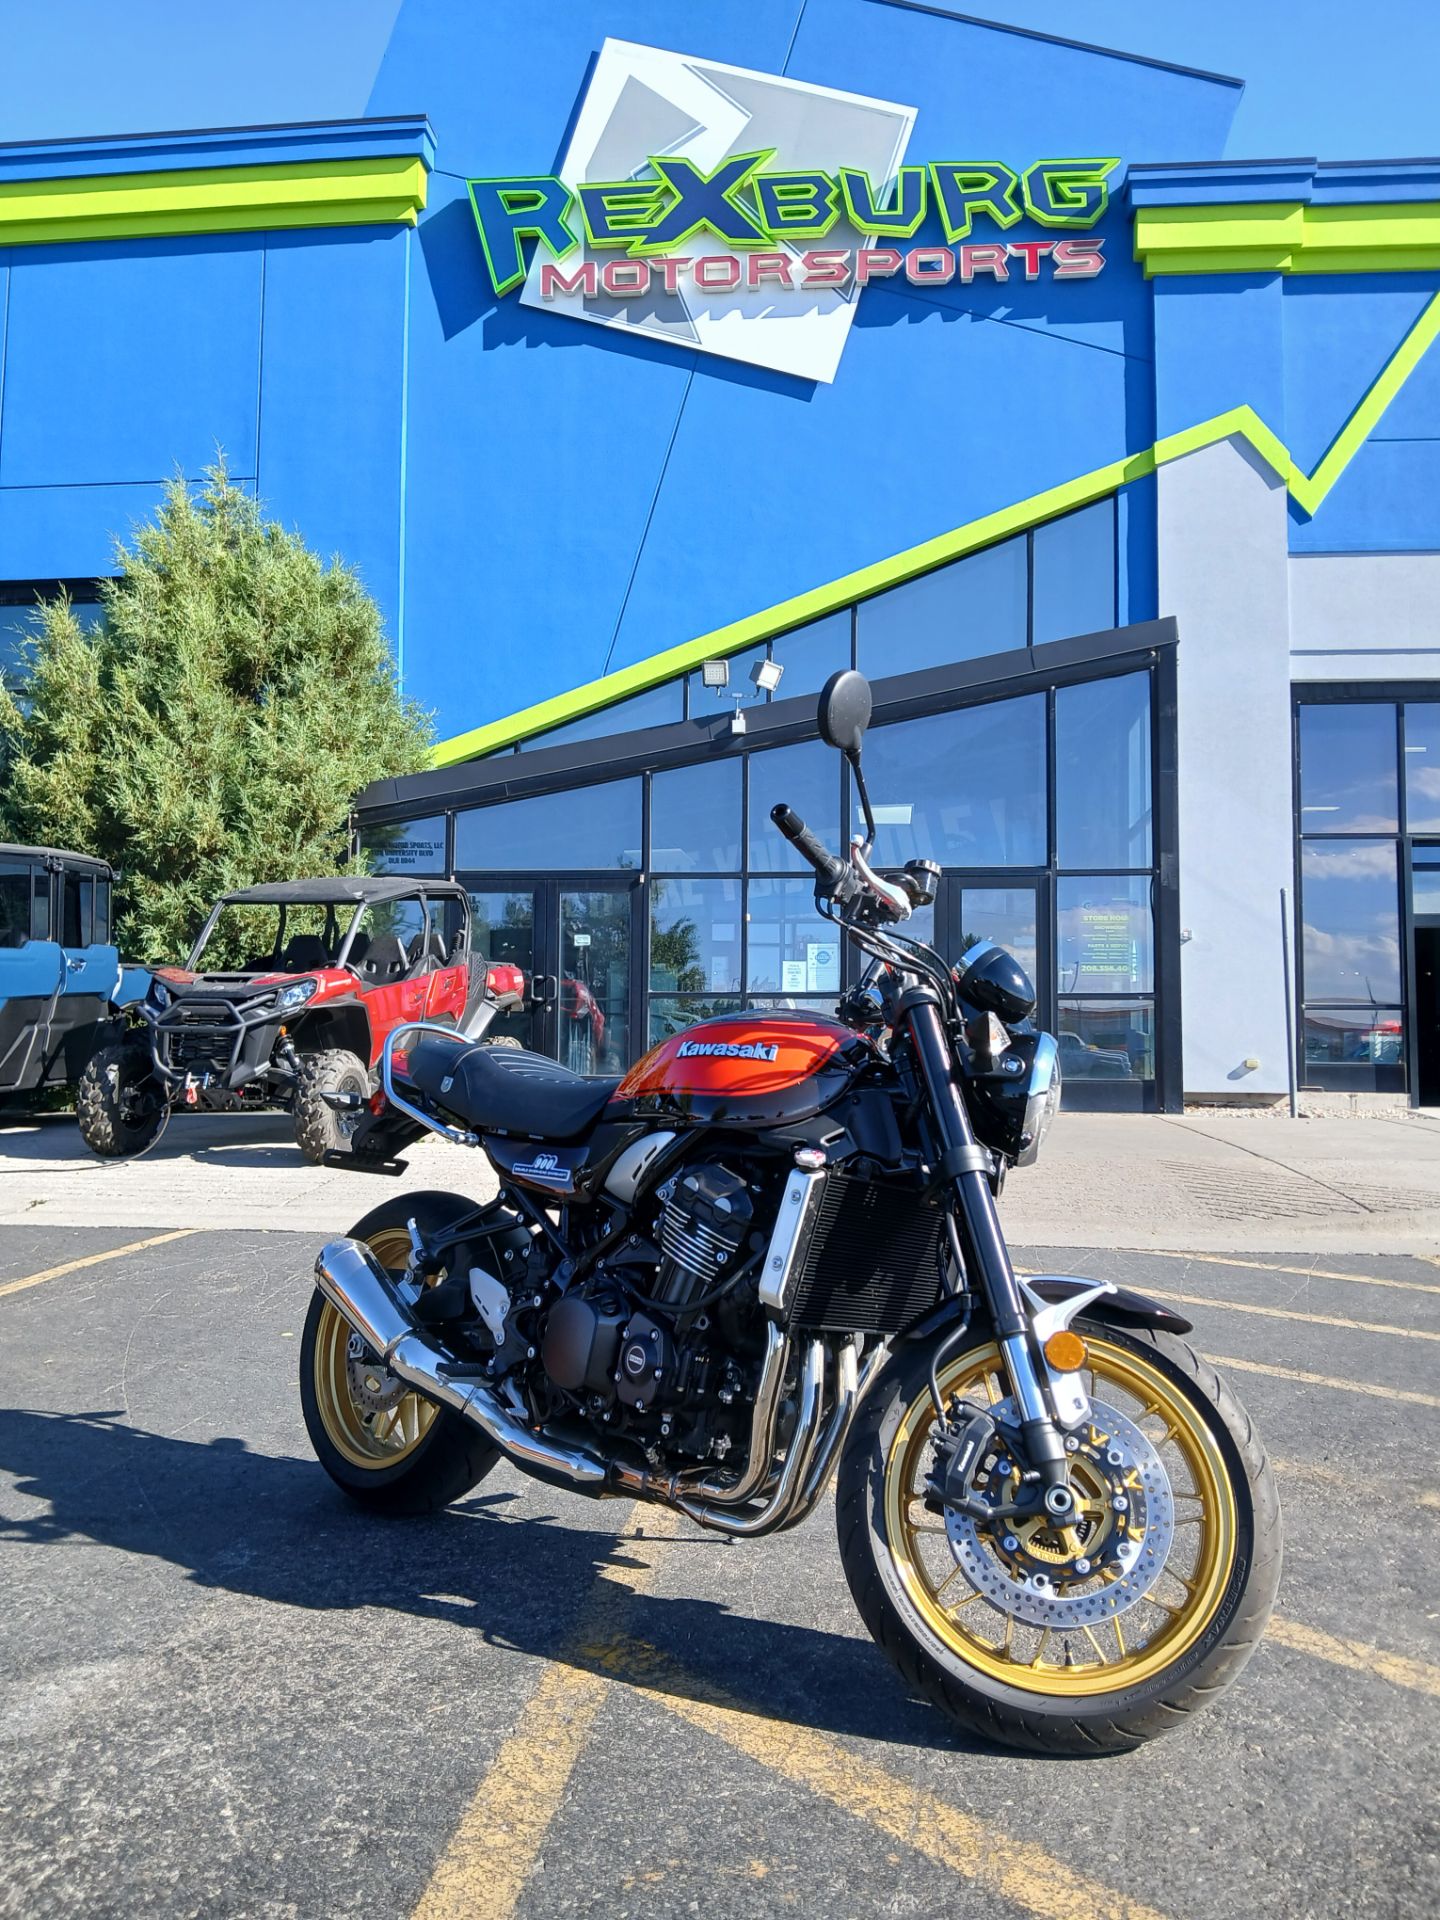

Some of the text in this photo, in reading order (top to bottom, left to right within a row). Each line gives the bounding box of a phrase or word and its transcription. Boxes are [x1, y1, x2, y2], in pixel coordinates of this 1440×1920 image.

[467, 148, 1121, 297] REXBURG
[539, 238, 1106, 299] MOTORSPORTS
[676, 1040, 779, 1062] Kawasaki
